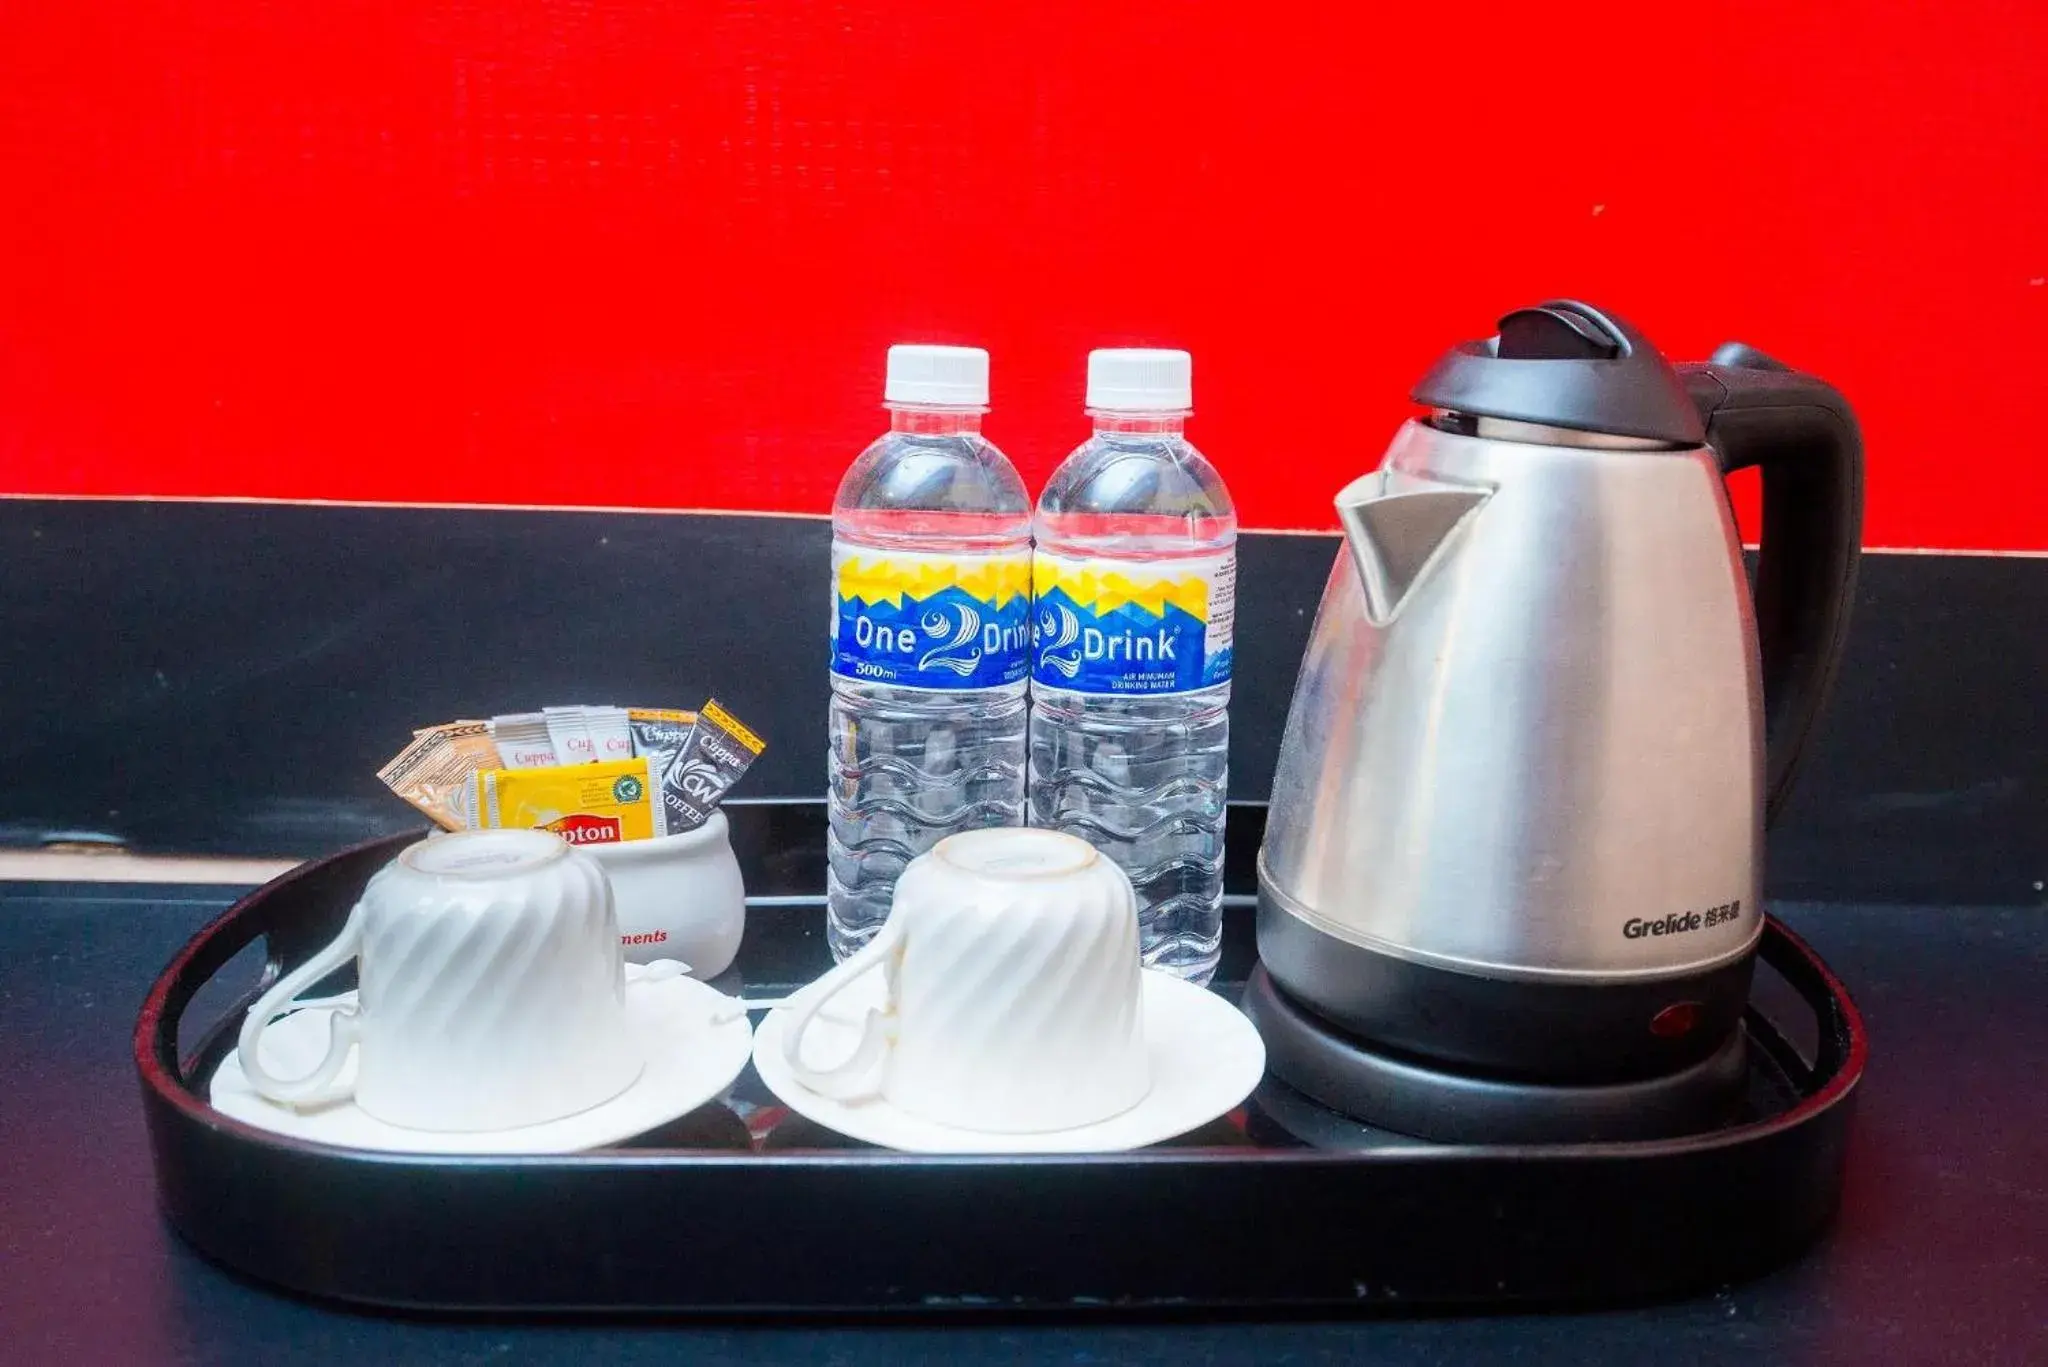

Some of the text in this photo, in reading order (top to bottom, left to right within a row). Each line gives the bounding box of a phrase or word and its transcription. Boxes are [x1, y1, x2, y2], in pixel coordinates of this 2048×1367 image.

[855, 615, 916, 653] One
[918, 602, 981, 677] 2
[983, 619, 1029, 655] Drin
[1040, 601, 1082, 678] 2
[1083, 627, 1177, 661] Drink
[855, 662, 897, 679] 500ml
[514, 751, 556, 766] Cuppa
[566, 738, 593, 752] Cup
[699, 734, 742, 768] Cuppa
[681, 773, 724, 804] CW
[560, 825, 615, 844] pton
[1623, 911, 1701, 939] Grelide
